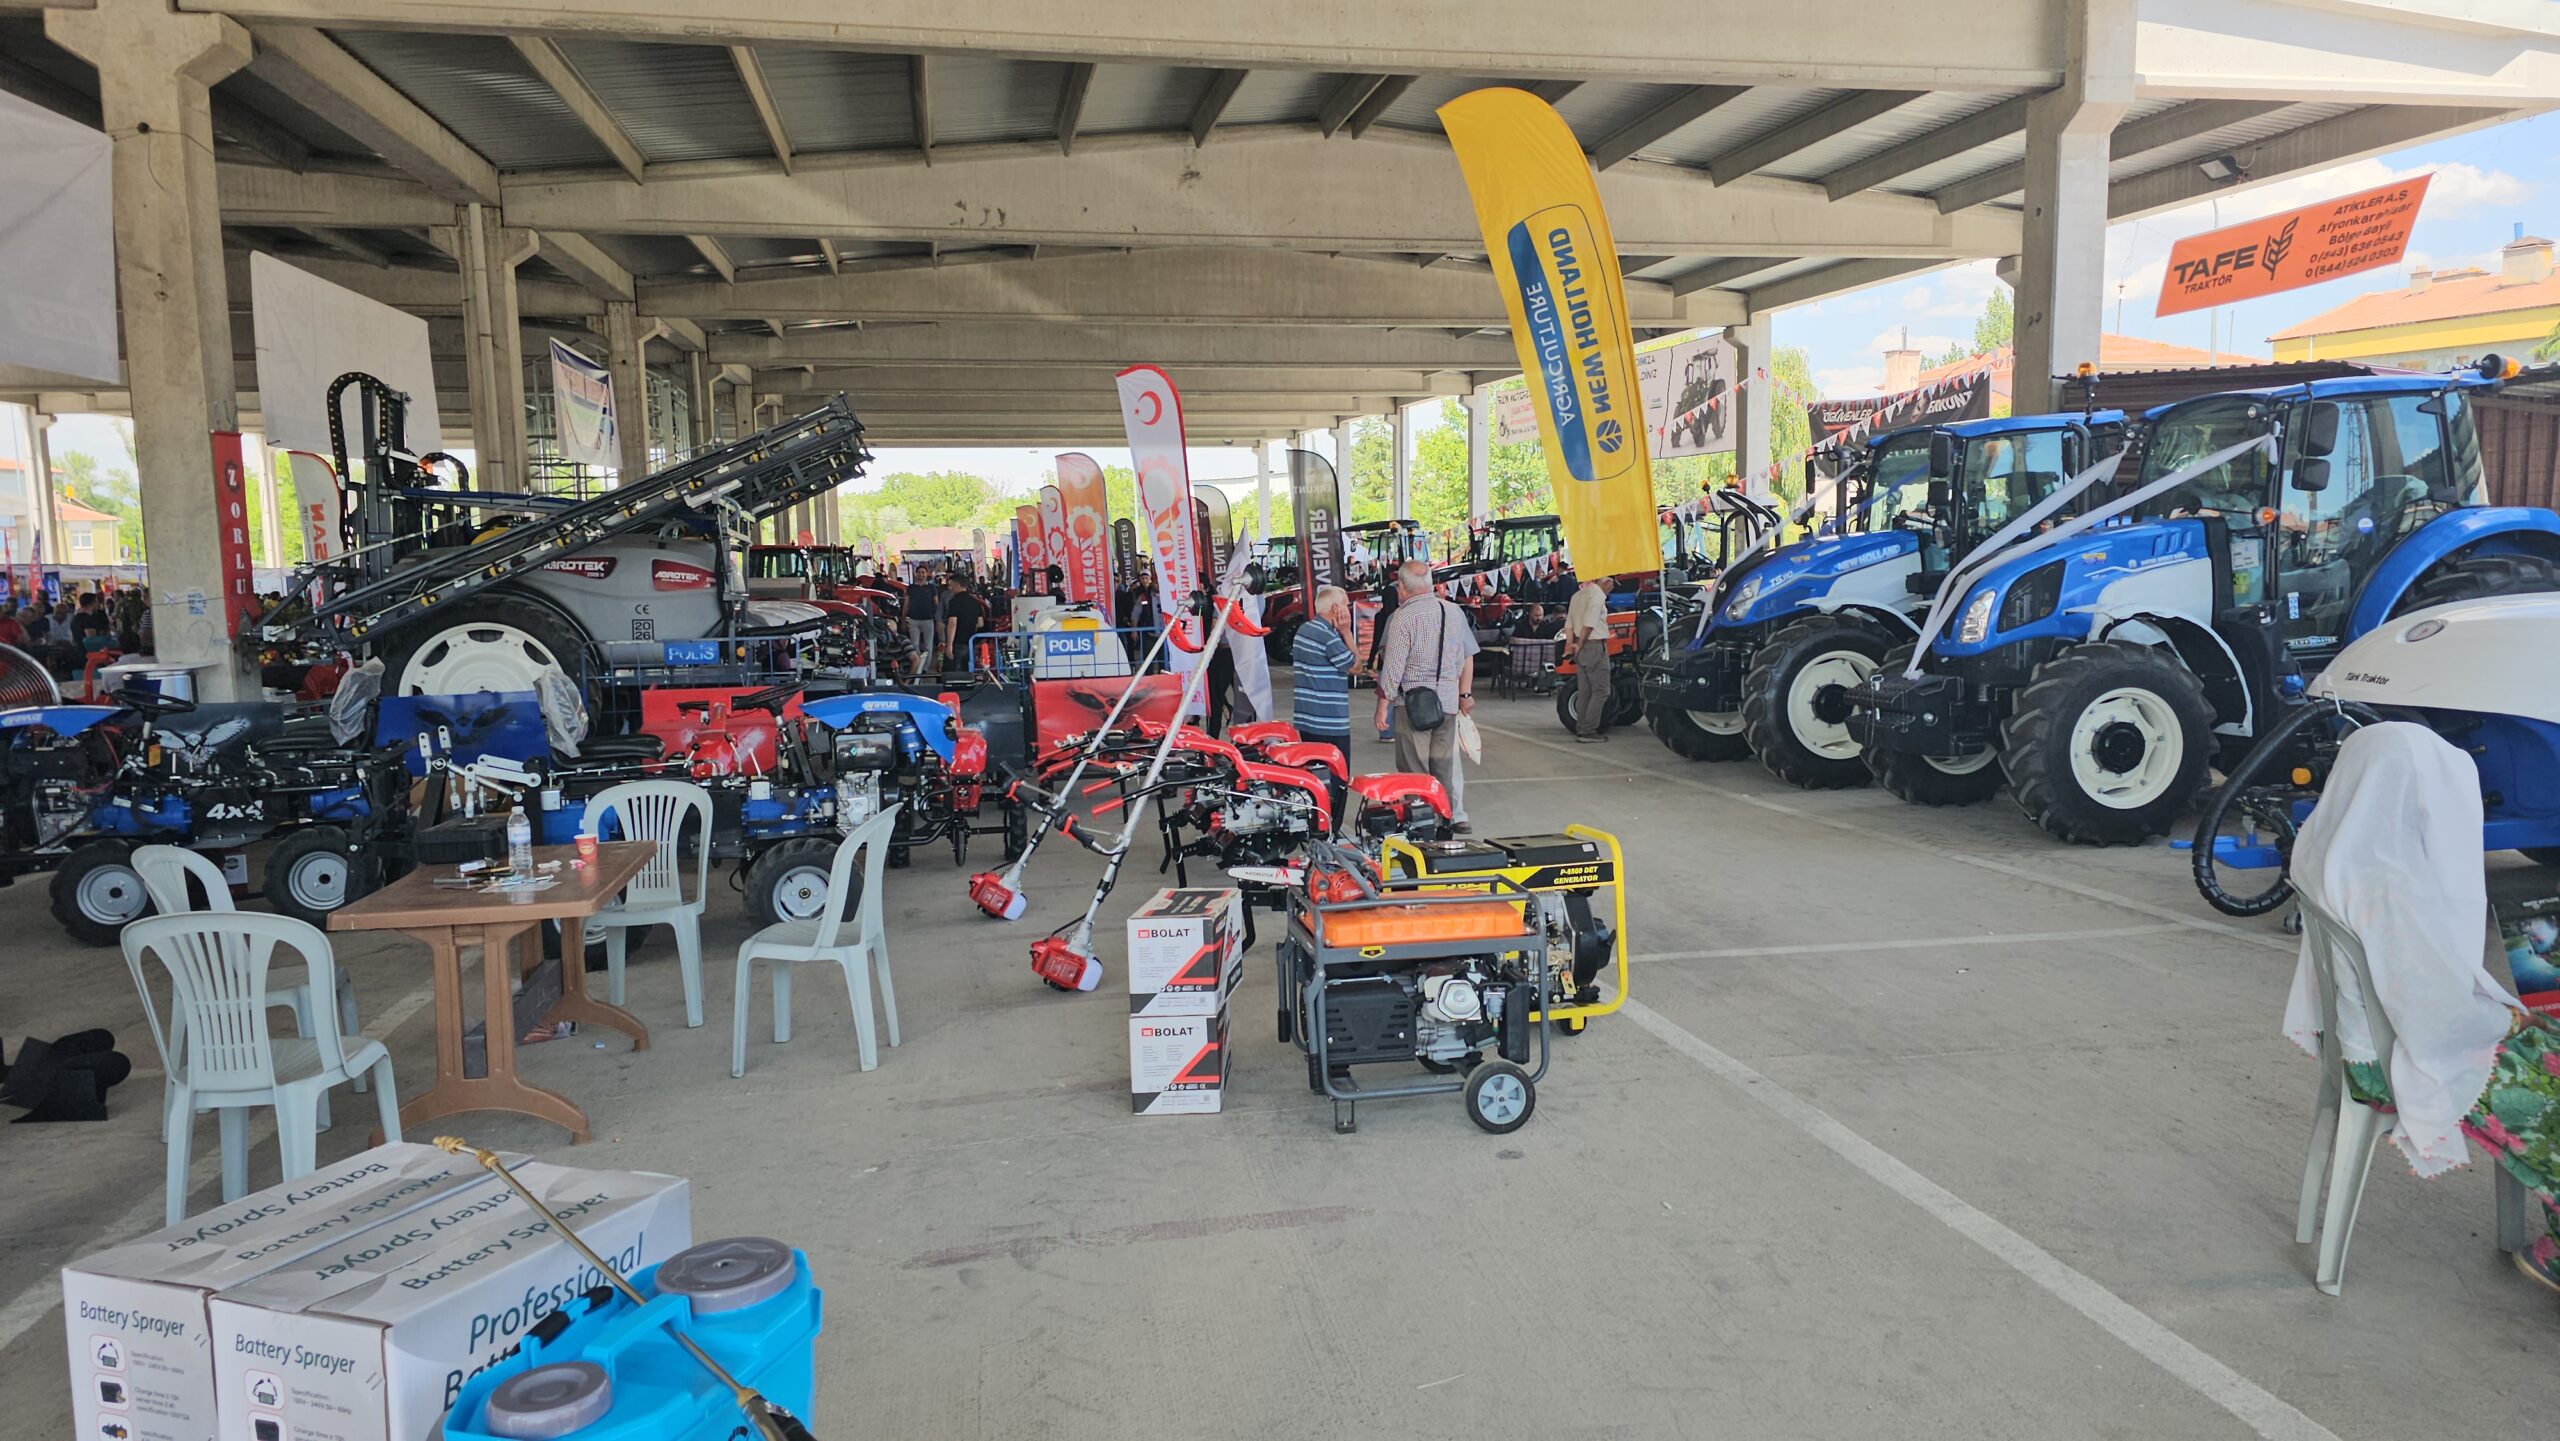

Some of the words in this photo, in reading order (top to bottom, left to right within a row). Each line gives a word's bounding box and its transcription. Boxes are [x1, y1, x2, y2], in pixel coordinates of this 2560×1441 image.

[2174, 244, 2258, 285] TAFE
[2184, 274, 2233, 295] TRAKTÖR
[634, 621, 651, 631] 20
[1049, 636, 1092, 652] POLİS
[1553, 874, 1599, 885] GENERATOR
[1151, 928, 1190, 938] BOLAT
[1154, 1027, 1194, 1037] BOLAT
[287, 1163, 391, 1207] Battery
[167, 1203, 286, 1254] Sprayer
[236, 1212, 351, 1261] Battery
[350, 1167, 454, 1215] Sprayer
[315, 1227, 433, 1281] Sprayer
[401, 1239, 513, 1291] Battery
[508, 1191, 610, 1240] Spayer
[80, 1300, 129, 1331] Battery
[132, 1310, 185, 1338] Sprayer
[235, 1333, 291, 1366] Battery
[294, 1345, 356, 1375] Sprayer
